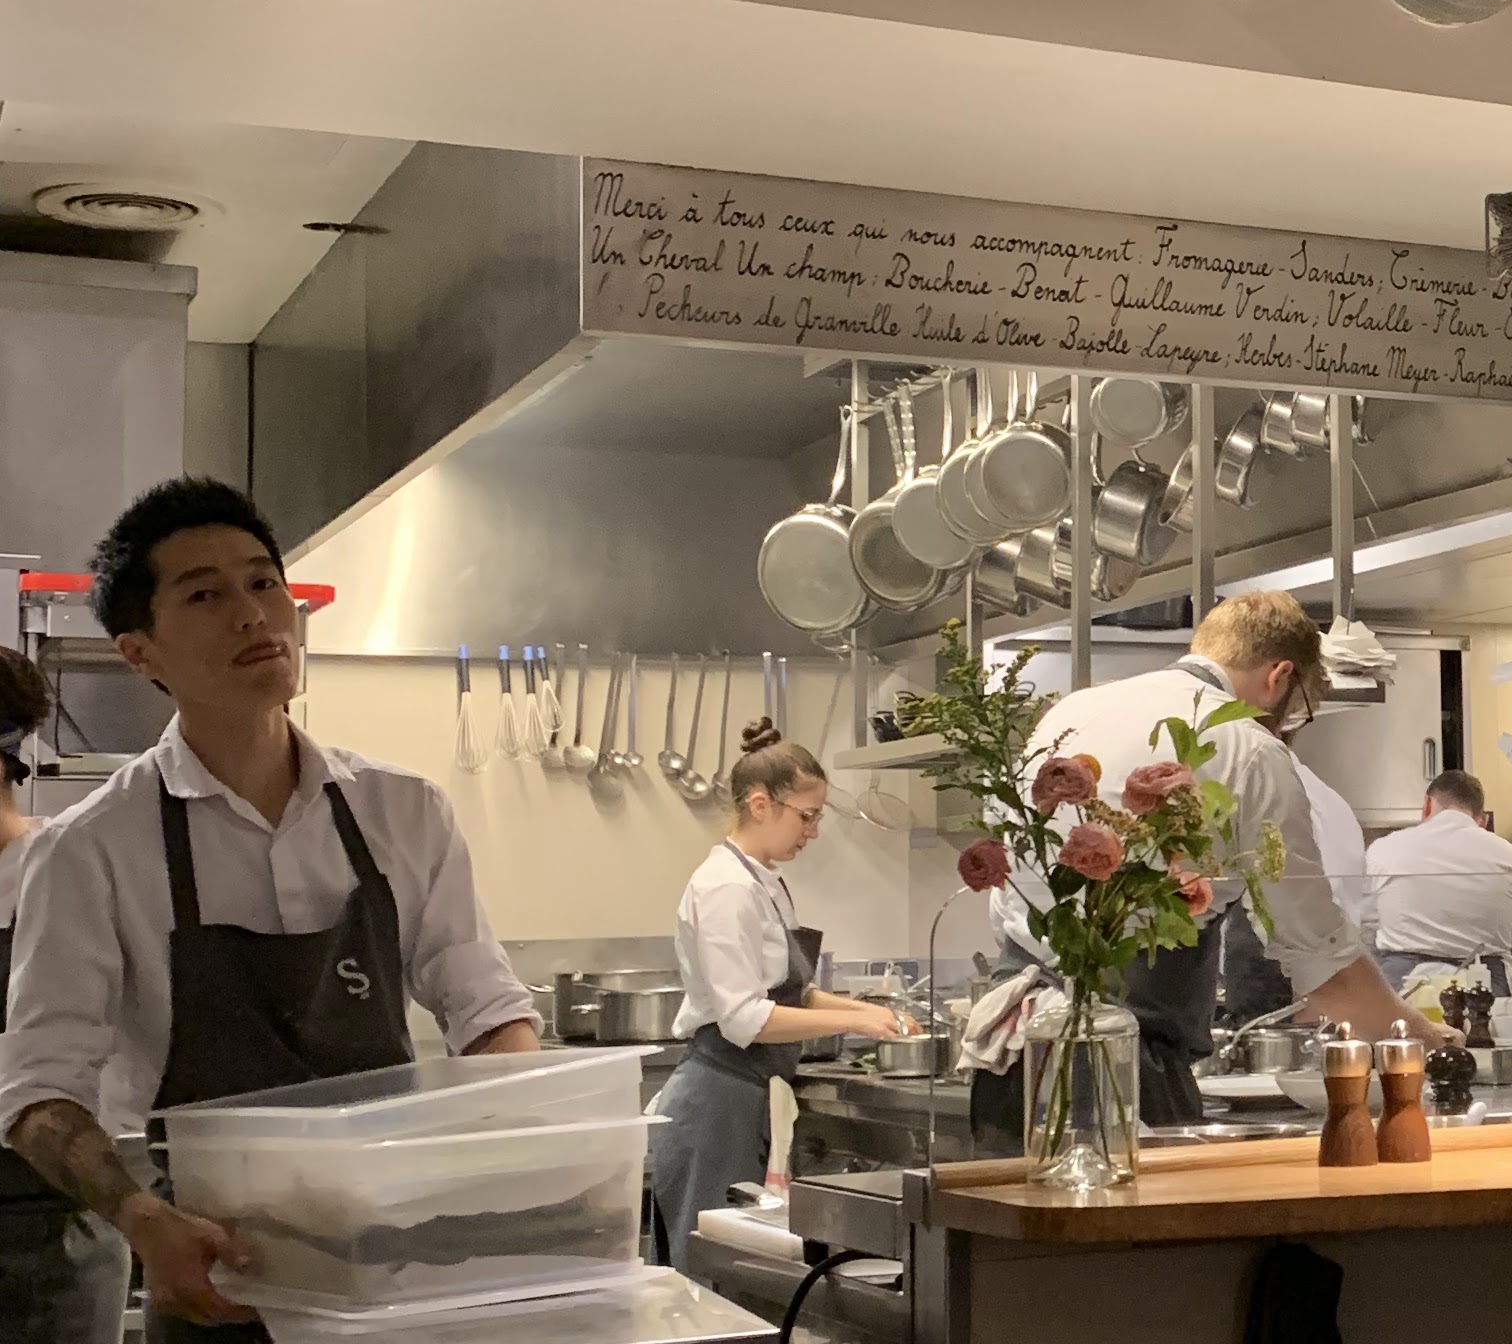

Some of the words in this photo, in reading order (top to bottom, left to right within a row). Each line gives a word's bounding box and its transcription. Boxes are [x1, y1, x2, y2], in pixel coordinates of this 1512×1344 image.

[590, 224, 627, 265] Un
[638, 228, 726, 272] Cheval
[737, 239, 775, 277] Un
[884, 252, 993, 296] Boucherie
[1110, 272, 1226, 327] Guillaume
[1327, 289, 1413, 333] Volaille
[1433, 297, 1490, 338] Fleur
[594, 172, 668, 221] Merci
[678, 192, 704, 224] à
[713, 189, 766, 229] tous
[779, 214, 836, 237] ceux
[847, 219, 889, 256] qui
[900, 227, 957, 248] nous
[1152, 224, 1273, 290] Fromagerie
[753, 295, 786, 329] de
[794, 296, 901, 344] Granville
[1235, 331, 1292, 369] Herbes
[1385, 345, 1440, 394] Meyer
